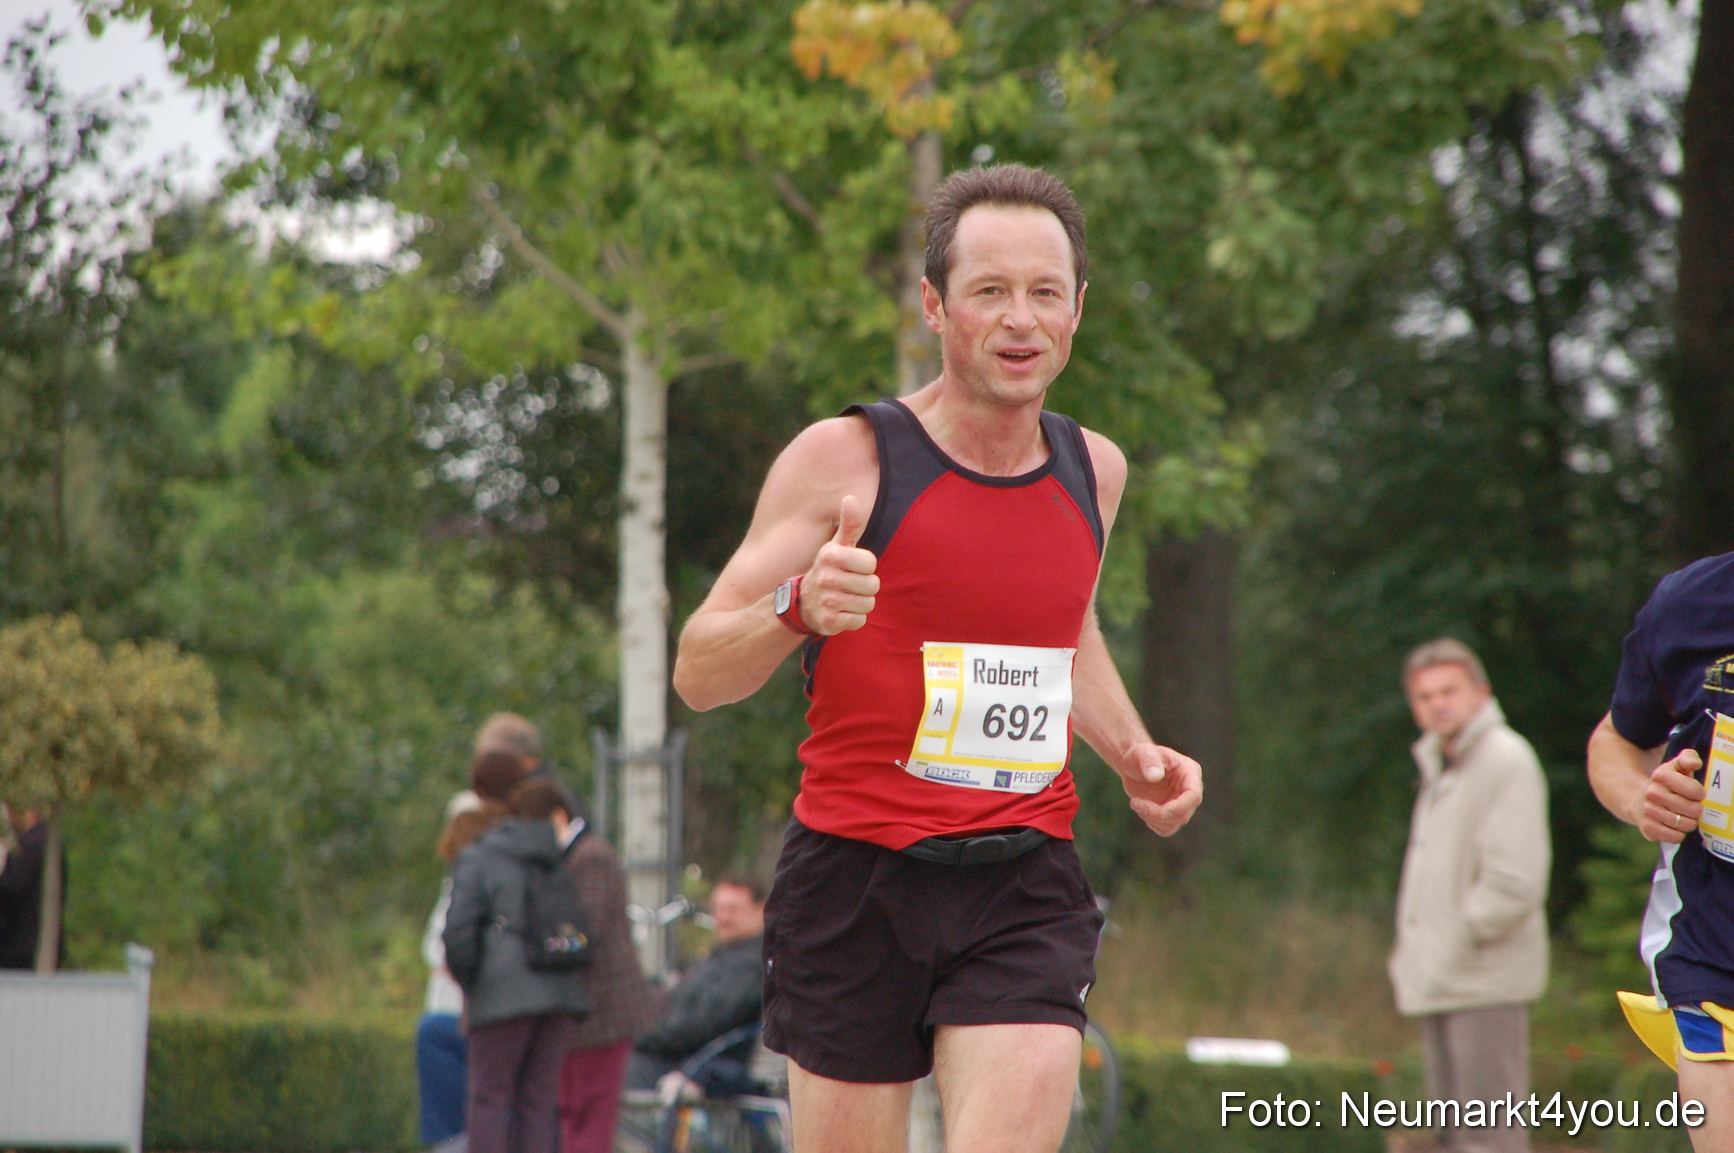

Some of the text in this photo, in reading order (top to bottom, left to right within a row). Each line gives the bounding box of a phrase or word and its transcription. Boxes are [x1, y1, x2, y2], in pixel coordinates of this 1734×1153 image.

[973, 658, 1039, 687] Robert
[933, 697, 943, 716] A
[982, 703, 1049, 742] 692
[1712, 769, 1721, 789] A
